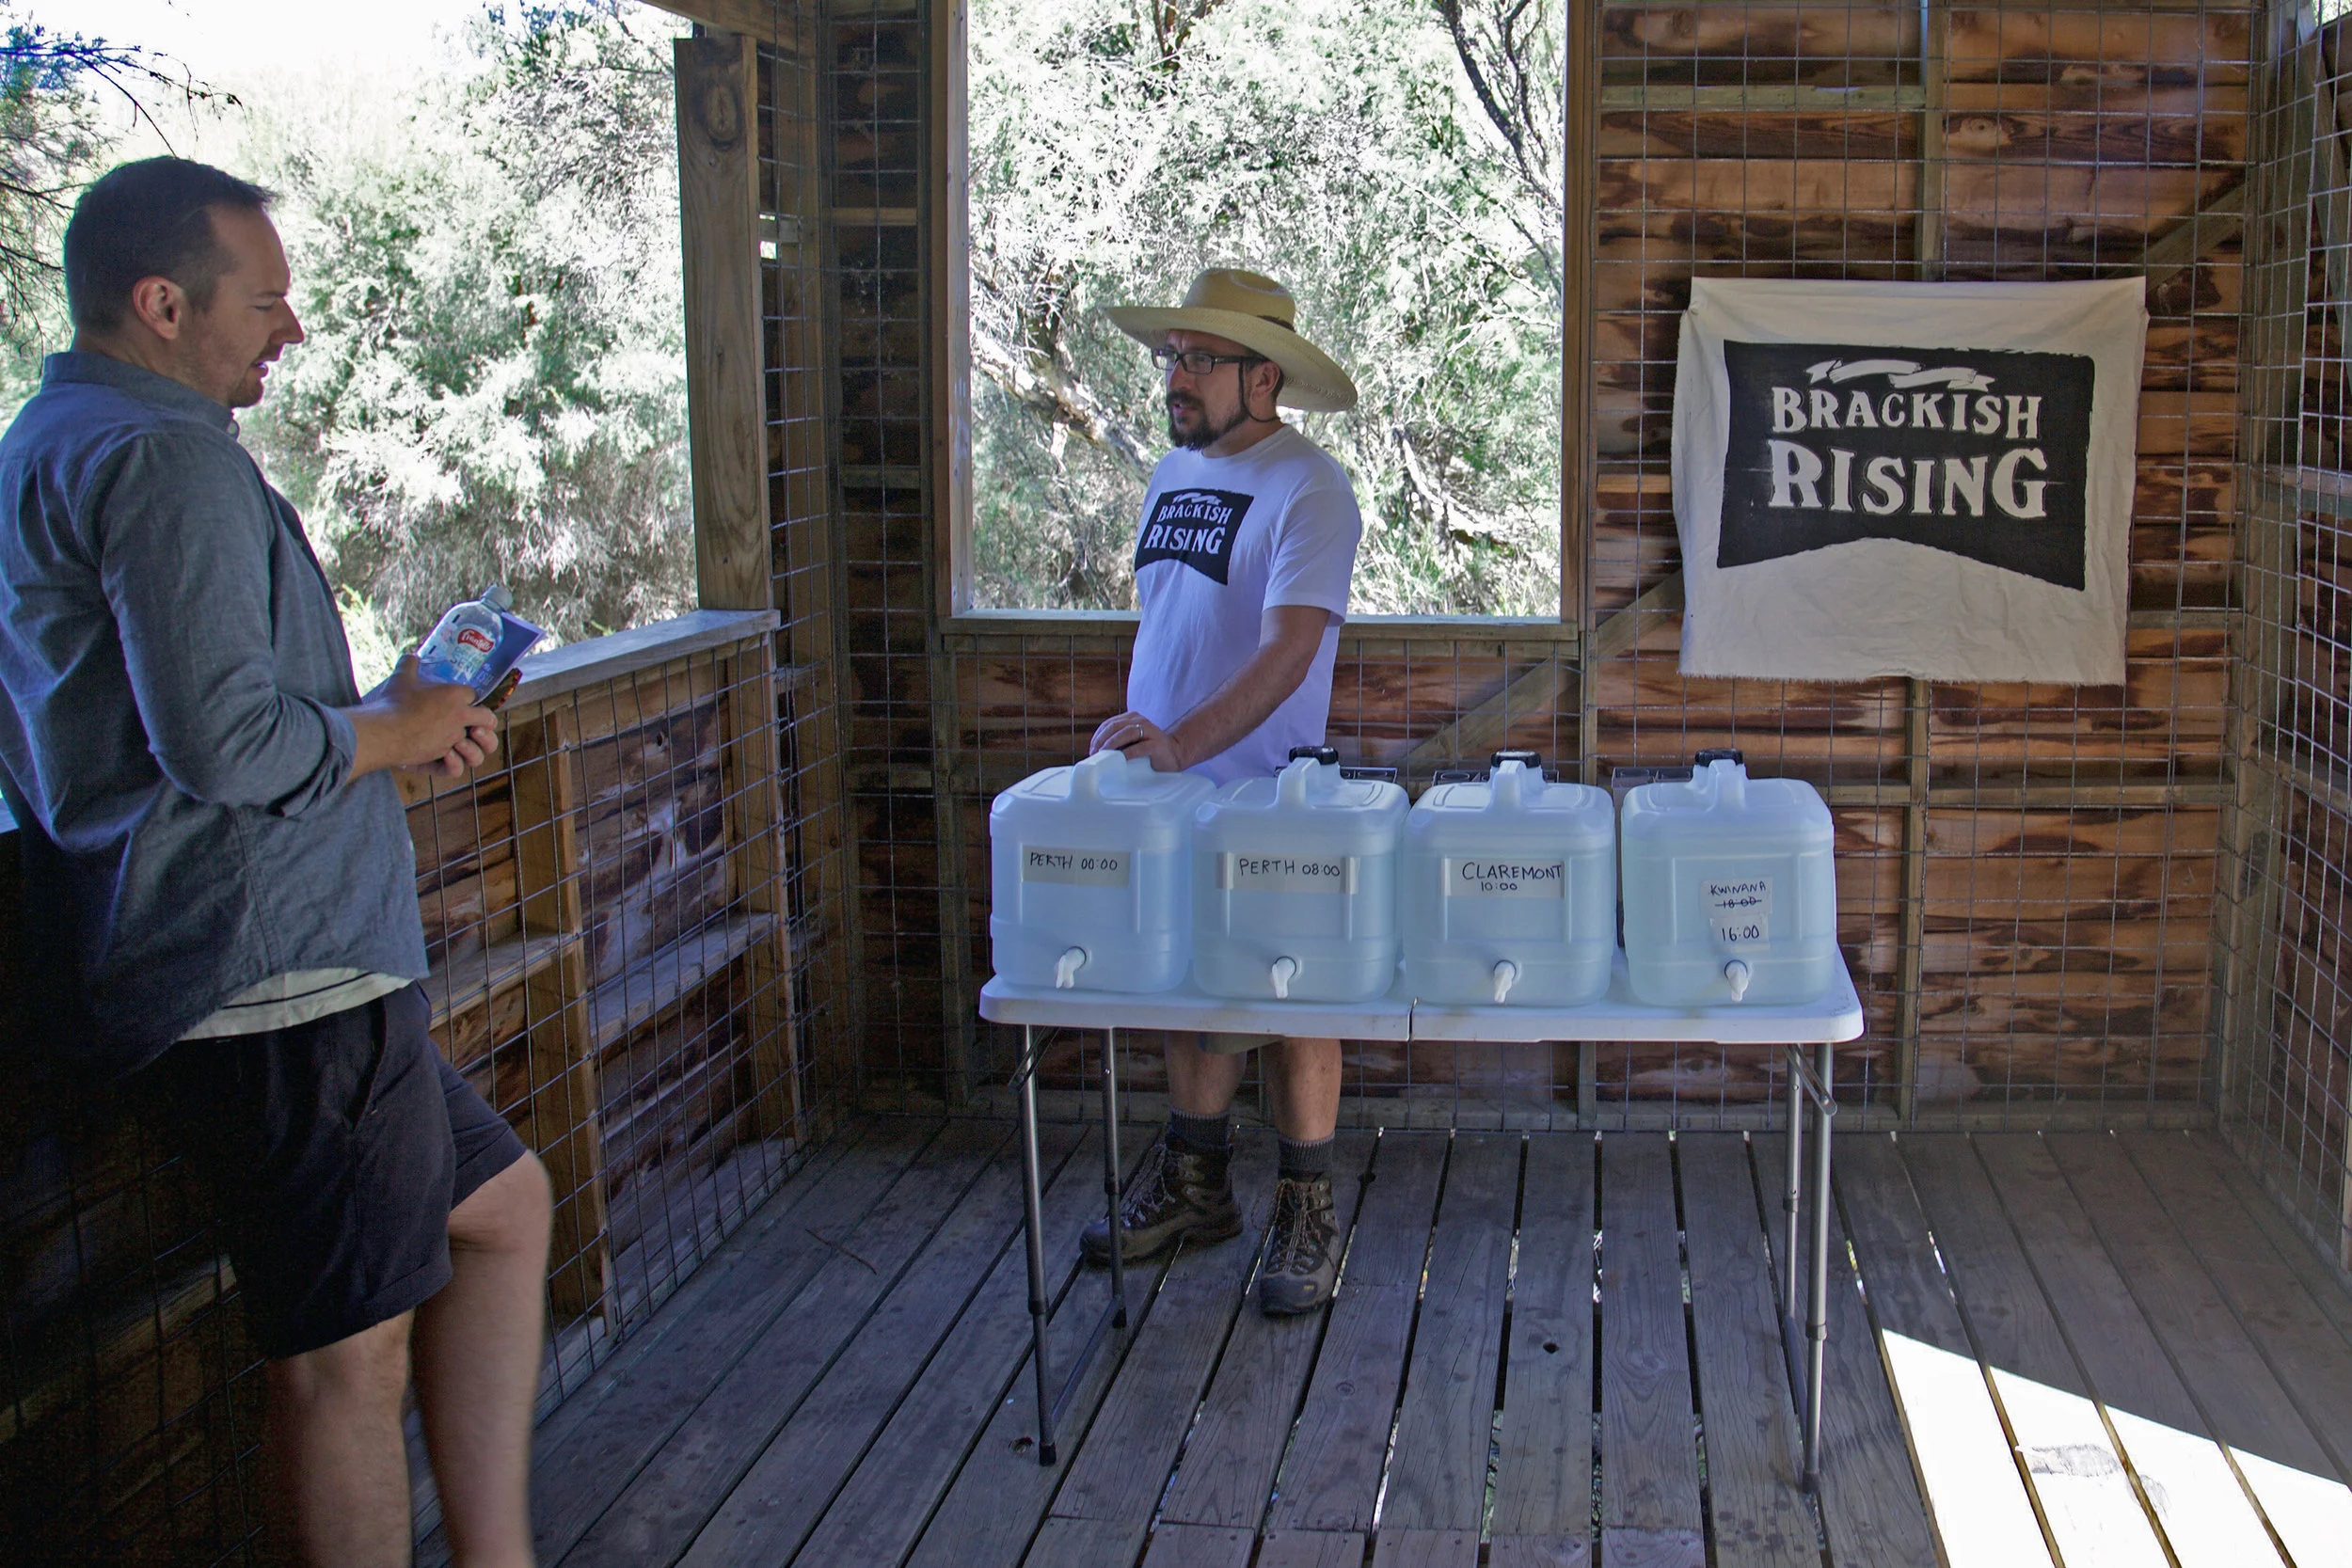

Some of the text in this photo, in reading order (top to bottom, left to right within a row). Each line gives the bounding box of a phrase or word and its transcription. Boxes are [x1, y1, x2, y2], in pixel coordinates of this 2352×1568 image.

[1771, 387, 2042, 439] BRACKISH
[1767, 439, 2047, 518] RISING
[1158, 503, 1232, 524] BRACKISH
[1144, 525, 1225, 554] RISING
[1029, 851, 1119, 871] PERTH 00:00
[1238, 857, 1341, 878] PERTH 08:00
[1461, 861, 1563, 881] CLAREMONT
[1480, 880, 1518, 893] 10:00
[1709, 879, 1767, 896] KWINANA
[1721, 924, 1760, 942] 16:00
